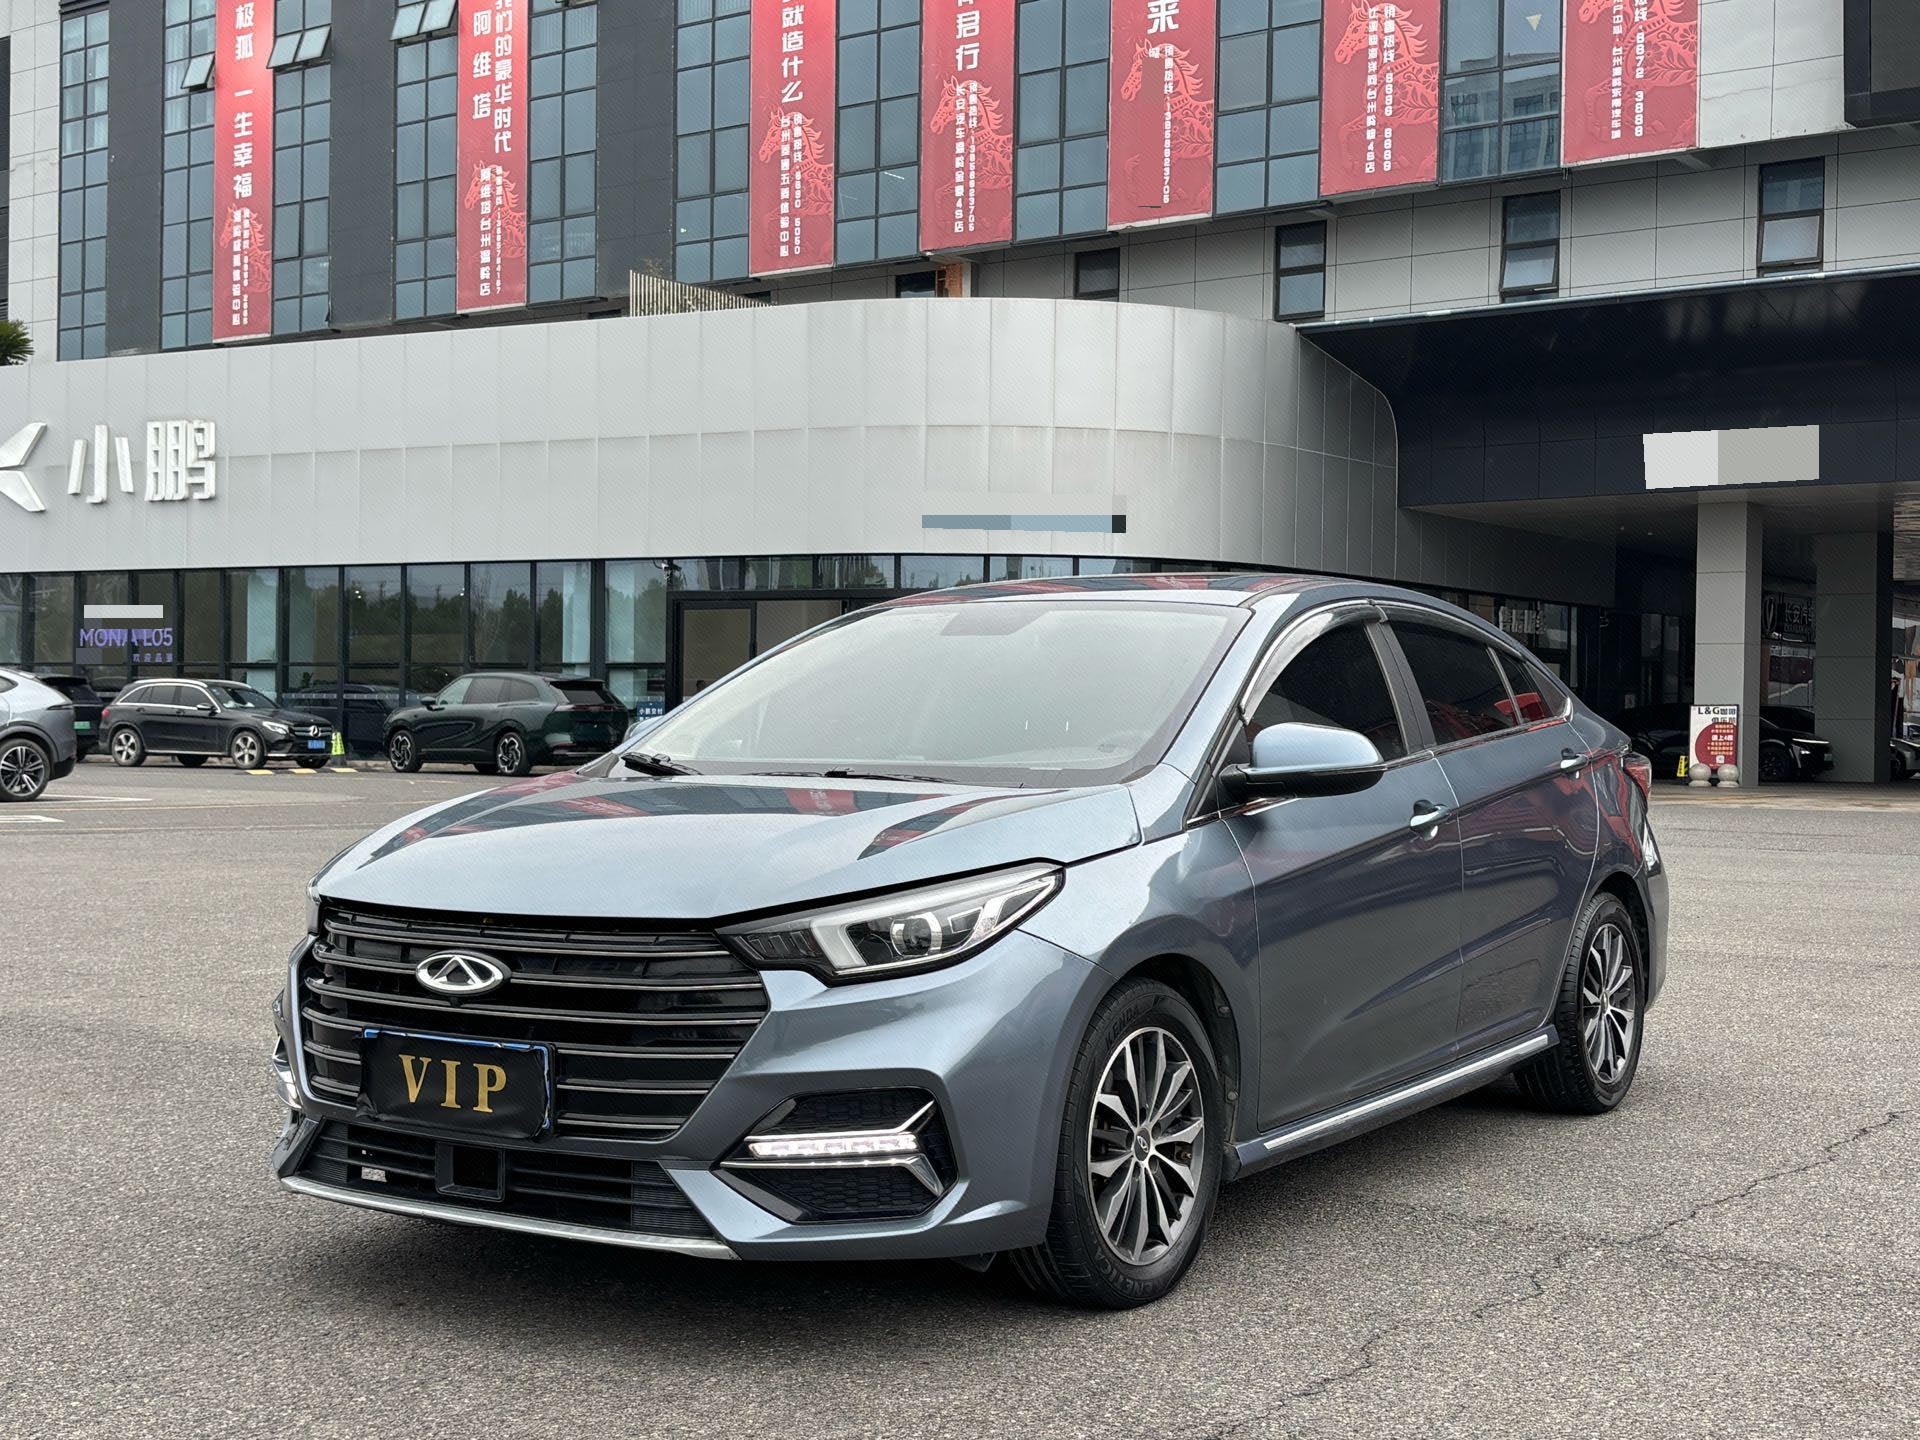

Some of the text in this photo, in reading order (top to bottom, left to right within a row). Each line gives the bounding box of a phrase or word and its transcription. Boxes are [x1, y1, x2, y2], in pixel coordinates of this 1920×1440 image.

[235, 3, 256, 60] 极狐
[782, 0, 804, 103] 就造什么
[955, 0, 980, 72] 君行
[1147, 0, 1180, 35] 来
[473, 10, 493, 120] 阿维塔
[233, 88, 254, 199] 一生幸福
[1634, 90, 1645, 137] 3888
[67, 419, 216, 504] 小鹏
[398, 1053, 507, 1113] VIP
